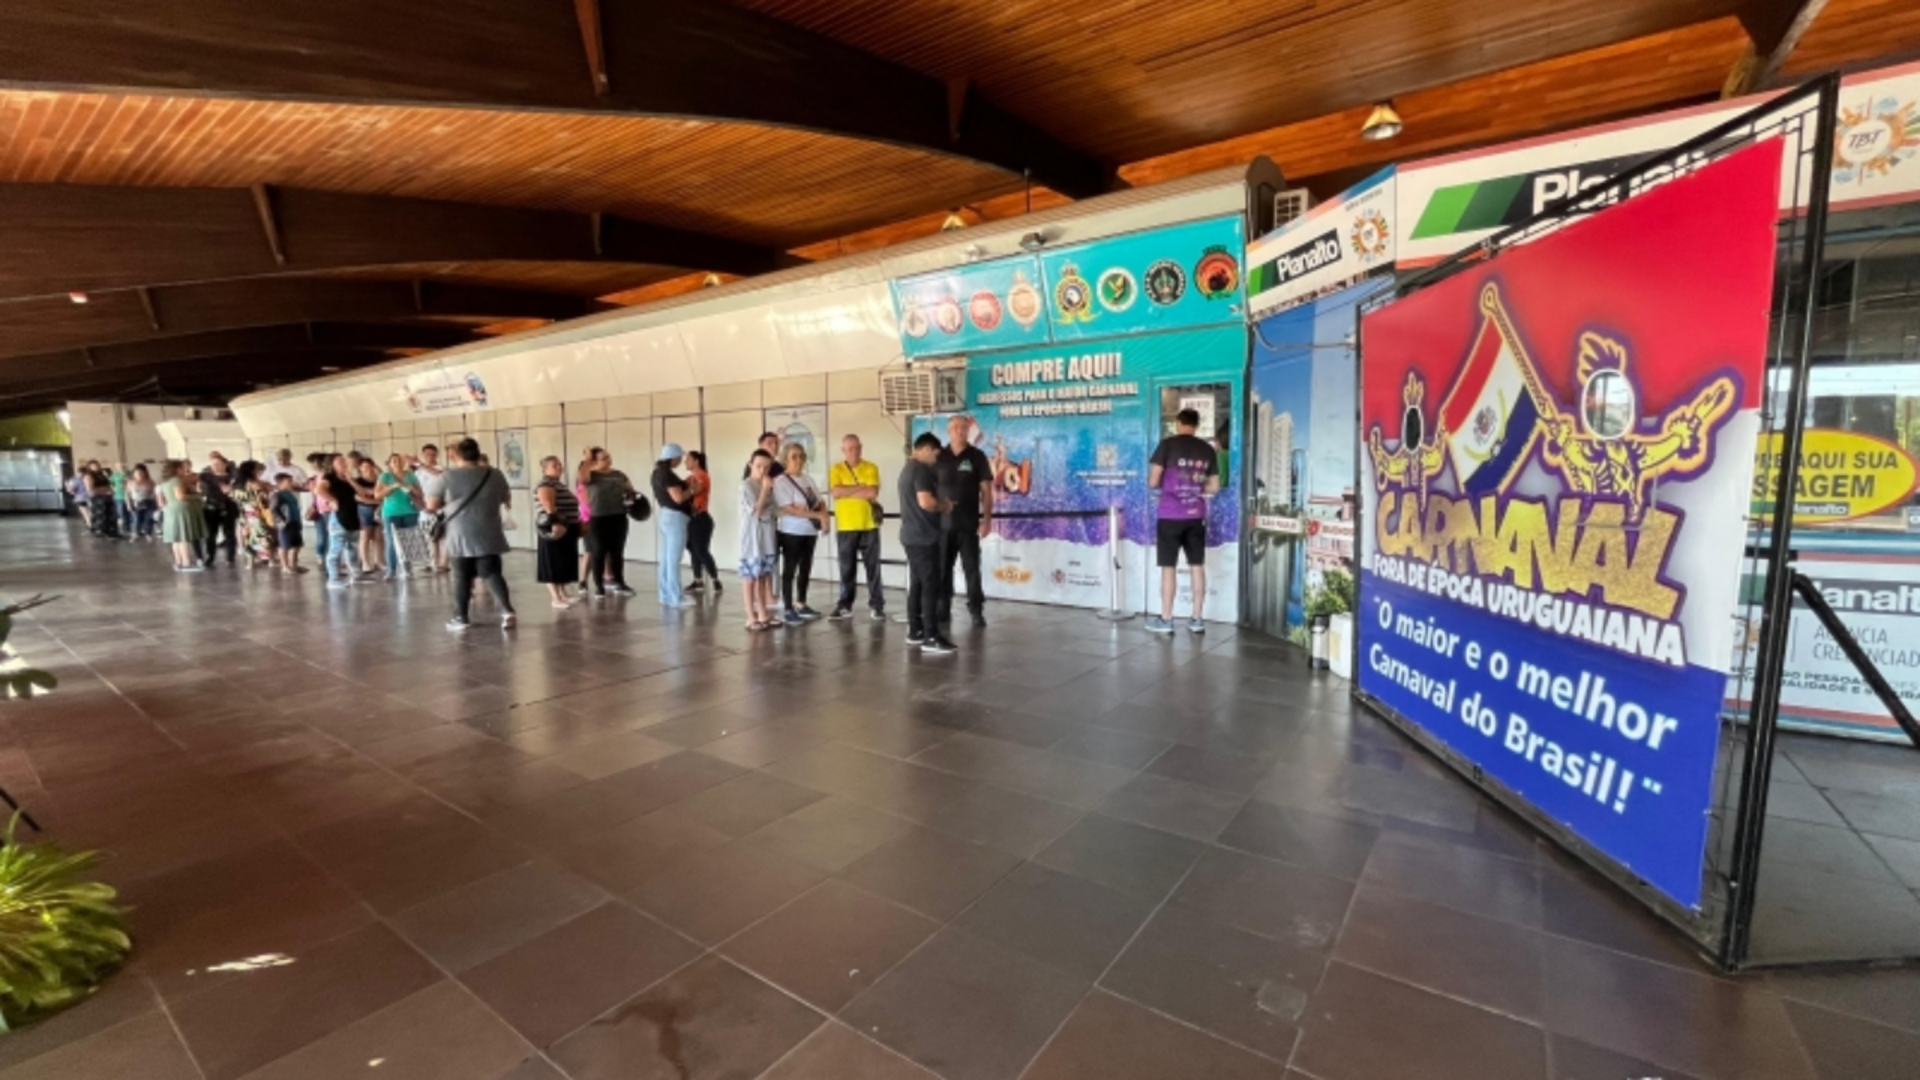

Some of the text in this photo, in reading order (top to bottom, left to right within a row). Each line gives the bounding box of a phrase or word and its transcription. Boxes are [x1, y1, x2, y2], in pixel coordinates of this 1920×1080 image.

[1276, 238, 1338, 281] Planalto
[992, 352, 1122, 386] COMPRE AQUI!
[1853, 451, 1898, 468] SUA
[1376, 491, 1680, 619] CARNAVAL
[1373, 554, 1686, 667] FORA DE ÉPOCA URUGUAIANA
[1369, 643, 1456, 714] Carnaval
[1460, 692, 1497, 737] do
[1395, 612, 1459, 659] maior
[1465, 641, 1481, 670] e
[1489, 652, 1509, 681] o
[1516, 661, 1678, 750] melhor
